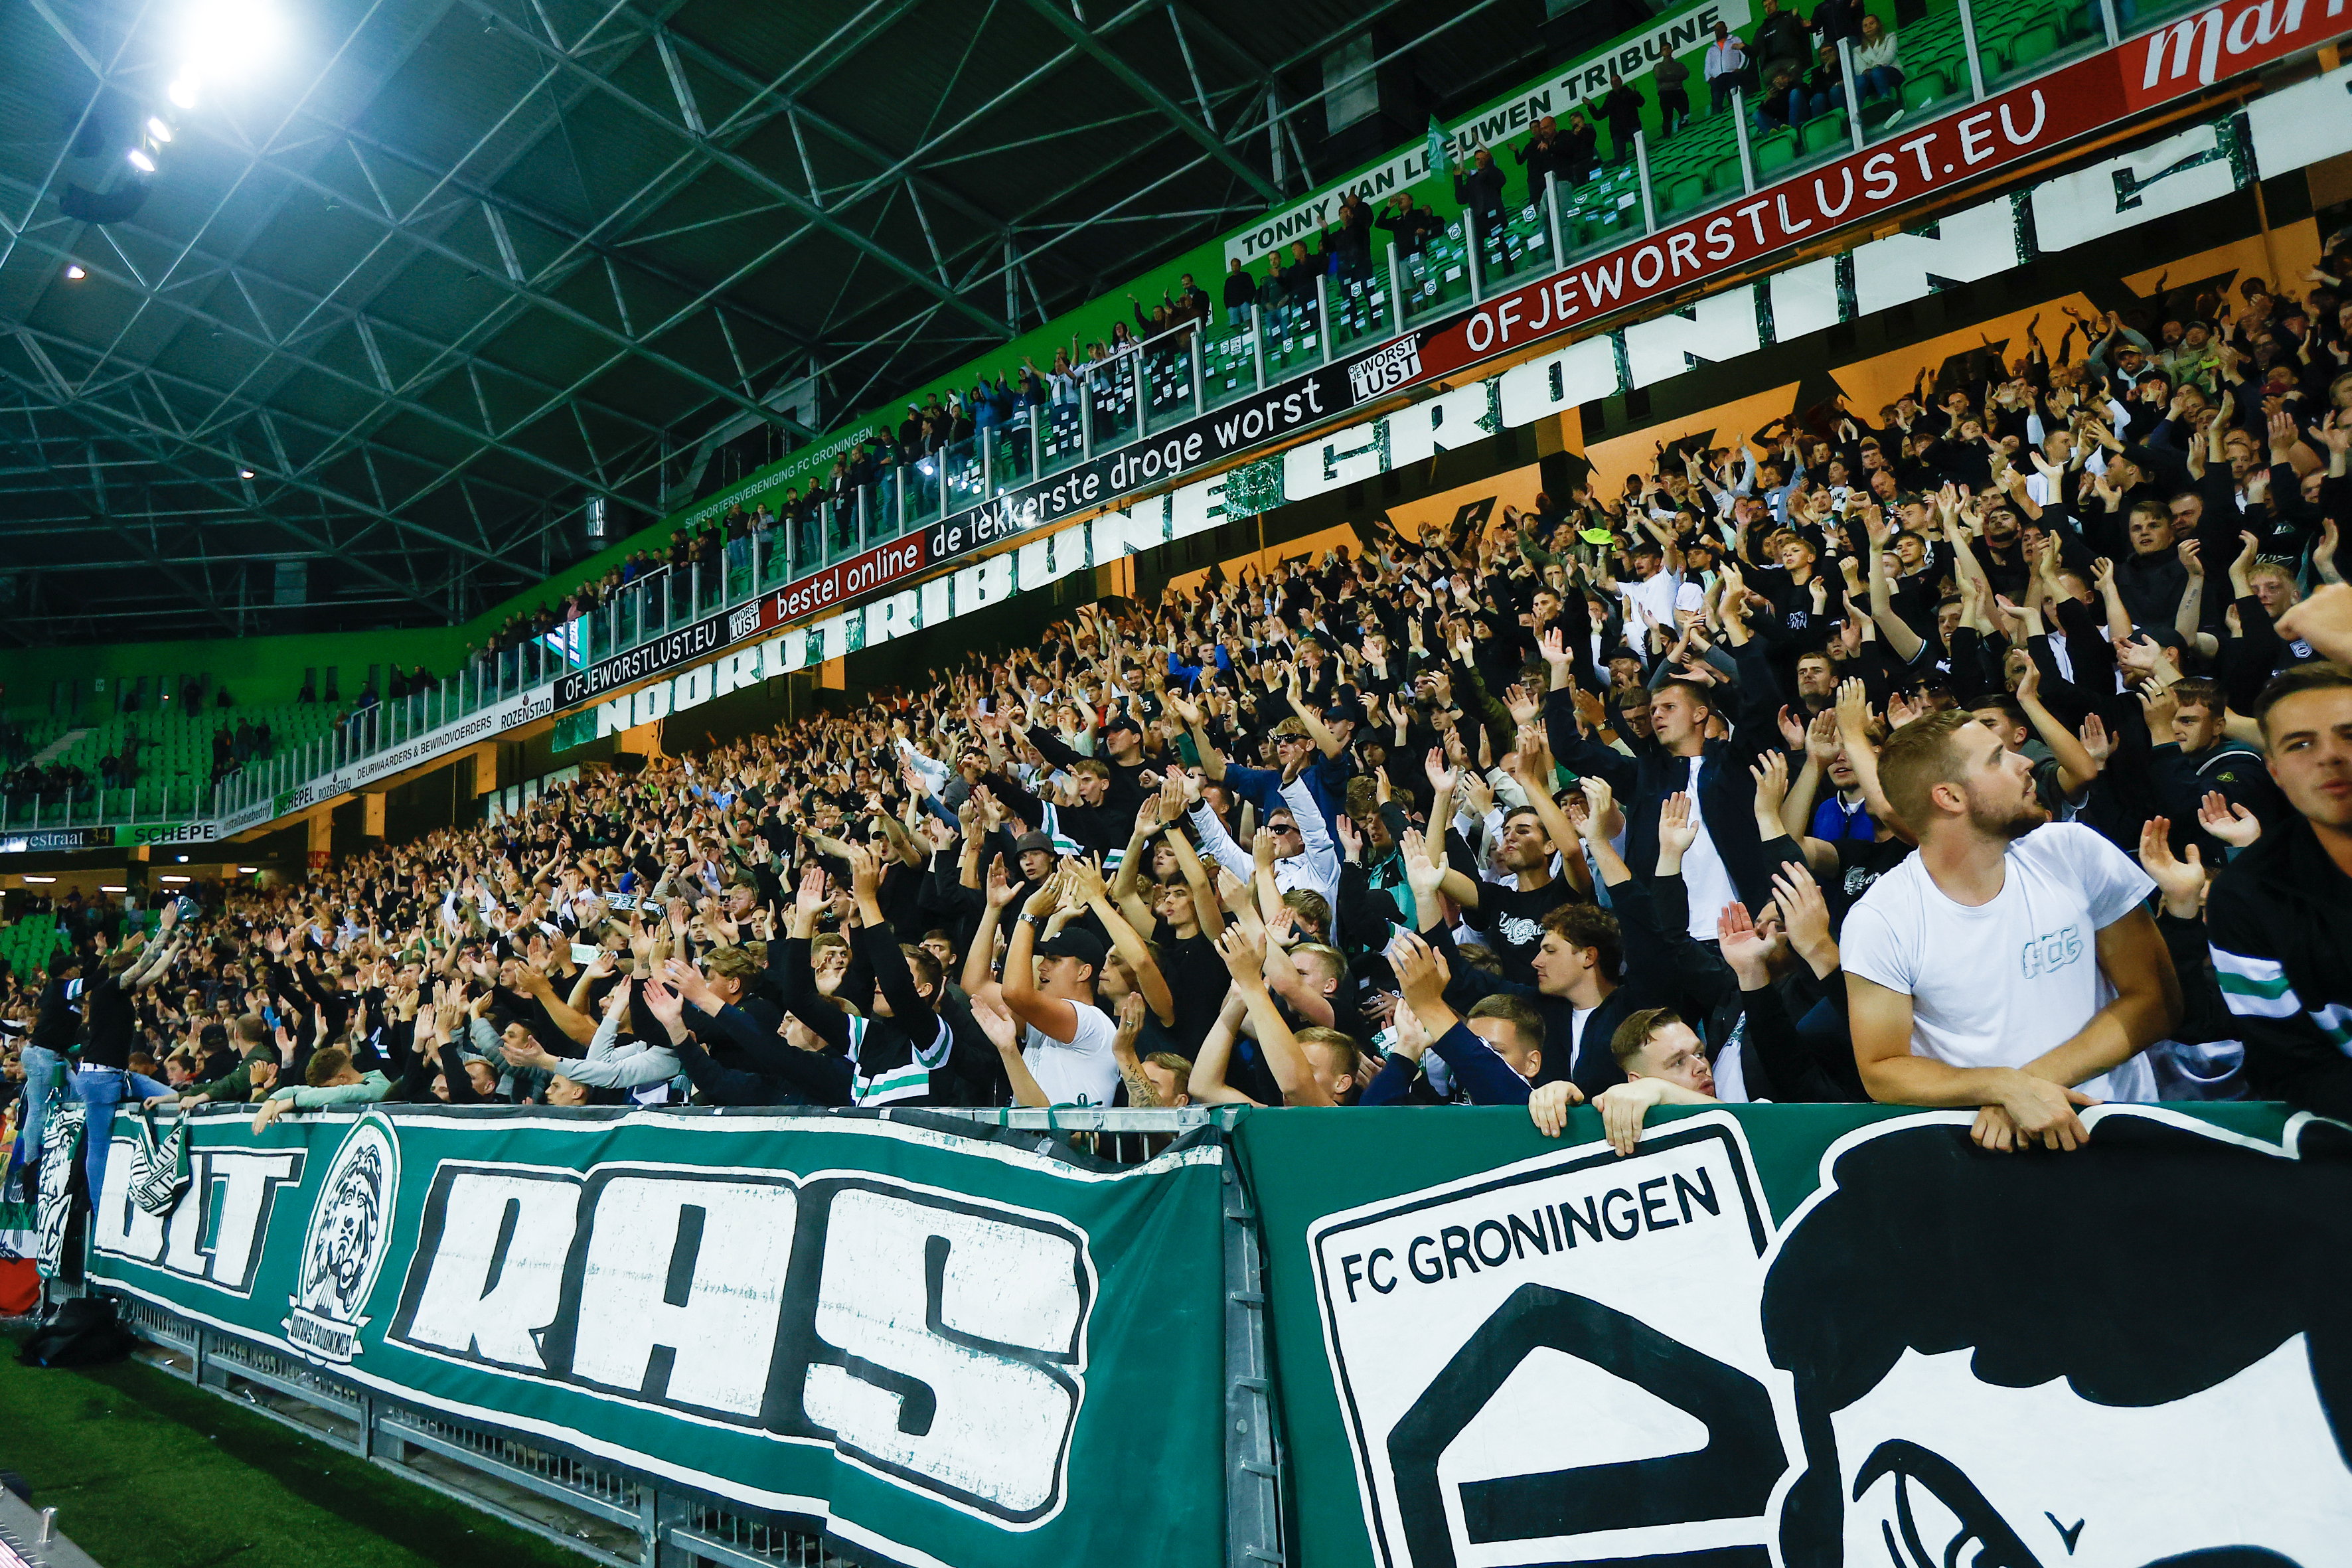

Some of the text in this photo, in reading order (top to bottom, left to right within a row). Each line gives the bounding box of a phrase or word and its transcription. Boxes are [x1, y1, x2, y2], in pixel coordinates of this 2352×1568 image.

[1241, 198, 1330, 256] TONNY
[1338, 167, 1395, 206] VAN
[1561, 5, 1719, 101] TRIBUNE
[1466, 89, 2046, 353] OFJEWORSTLUST.EU
[1349, 337, 1413, 375] OF WORST
[1352, 371, 1362, 381] JE
[1353, 351, 1417, 402] LUST
[685, 426, 873, 529] SUPPORTERSVERENIGING FC GRONINGEN
[777, 378, 1324, 621] bestel online de lekkerste droge worst
[730, 611, 759, 641] LUST
[734, 601, 758, 623] WORST
[566, 620, 717, 702] OFJEWORSTLUST.EU
[501, 697, 552, 730] ROZENSTAD
[319, 715, 492, 800] ROZENSTAD DEURWAARDERS & BEWINDVOERDERS
[278, 785, 314, 813] SCHEPEL
[1340, 1165, 1721, 1303] FC GRONINGEN
